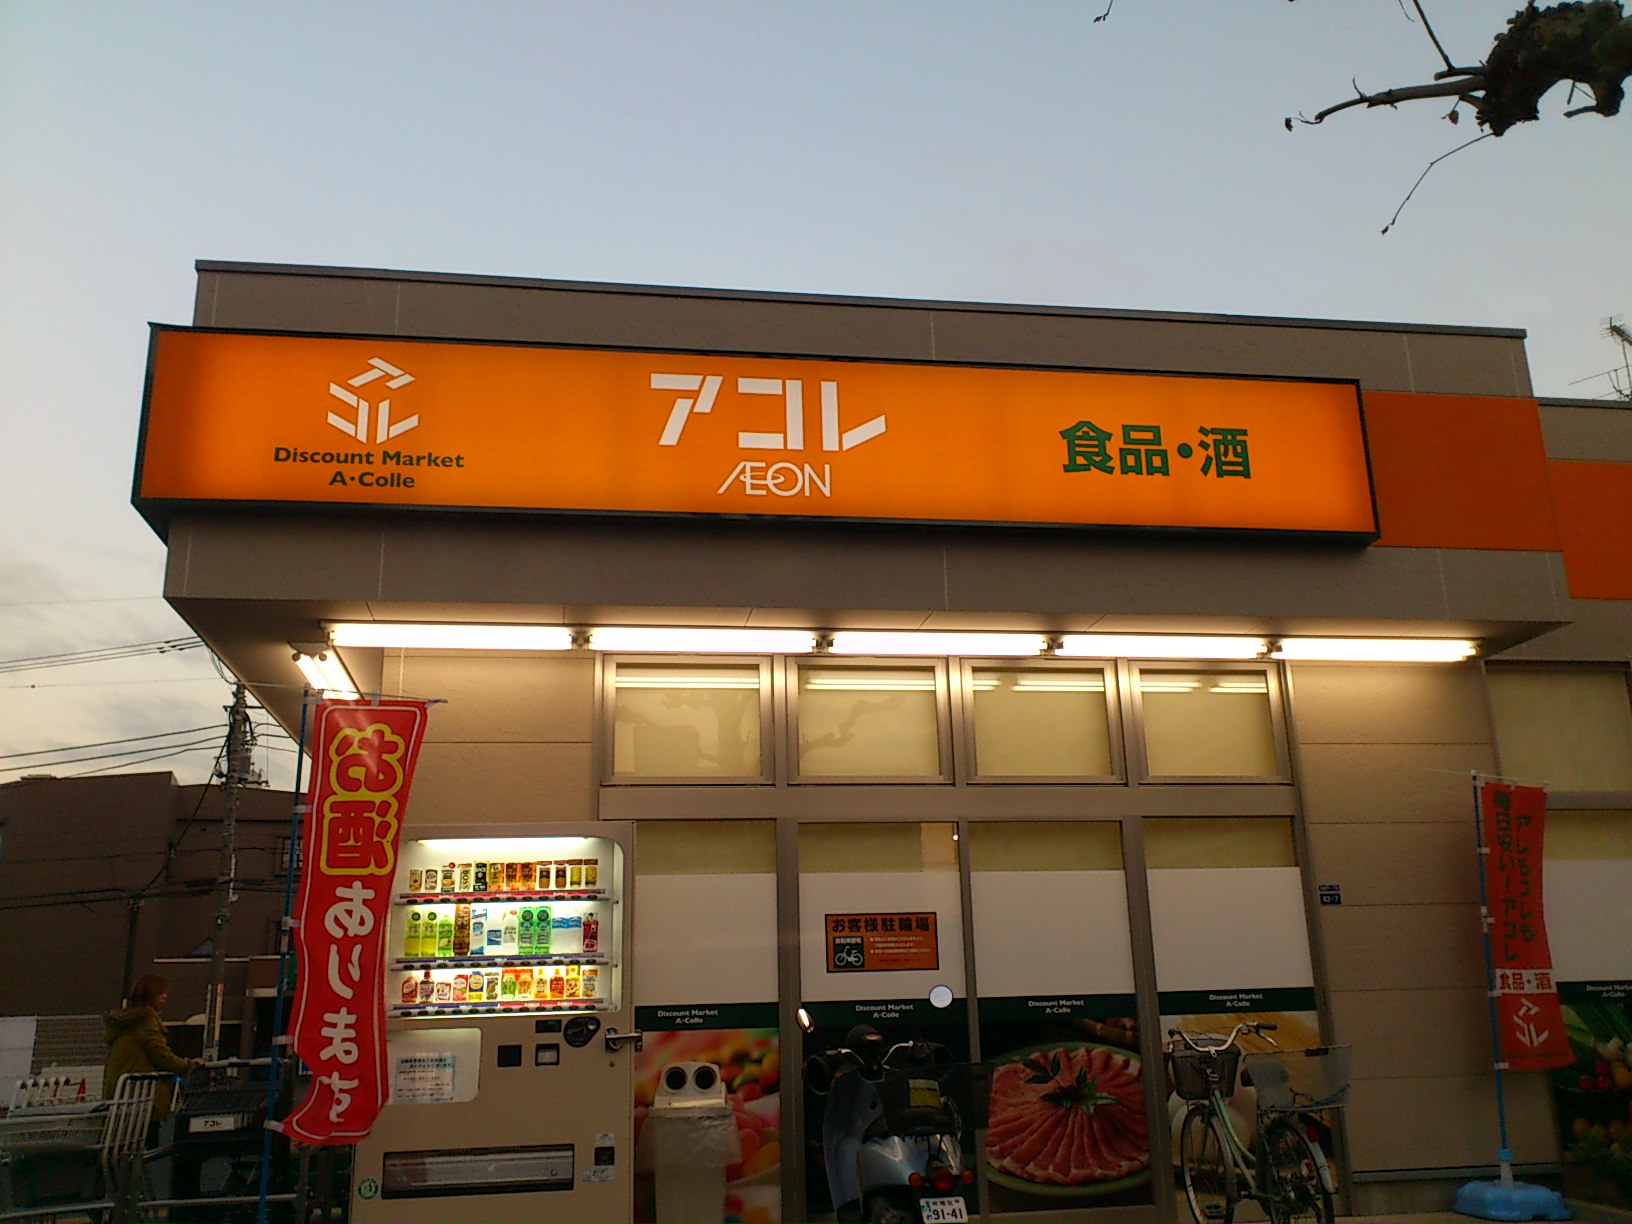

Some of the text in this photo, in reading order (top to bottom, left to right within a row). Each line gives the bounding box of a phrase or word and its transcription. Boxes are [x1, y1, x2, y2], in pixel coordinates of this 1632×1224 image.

[650, 373, 886, 452] アコレ
[274, 447, 464, 468] Discount Market
[1058, 420, 1252, 479] 食品・酒
[832, 916, 930, 933] お客様駐輪場
[1499, 972, 1552, 990] 食品・酒
[657, 1008, 719, 1017] Discount Market
[887, 1003, 914, 1011] Market
[932, 1208, 963, 1221] 91-41
